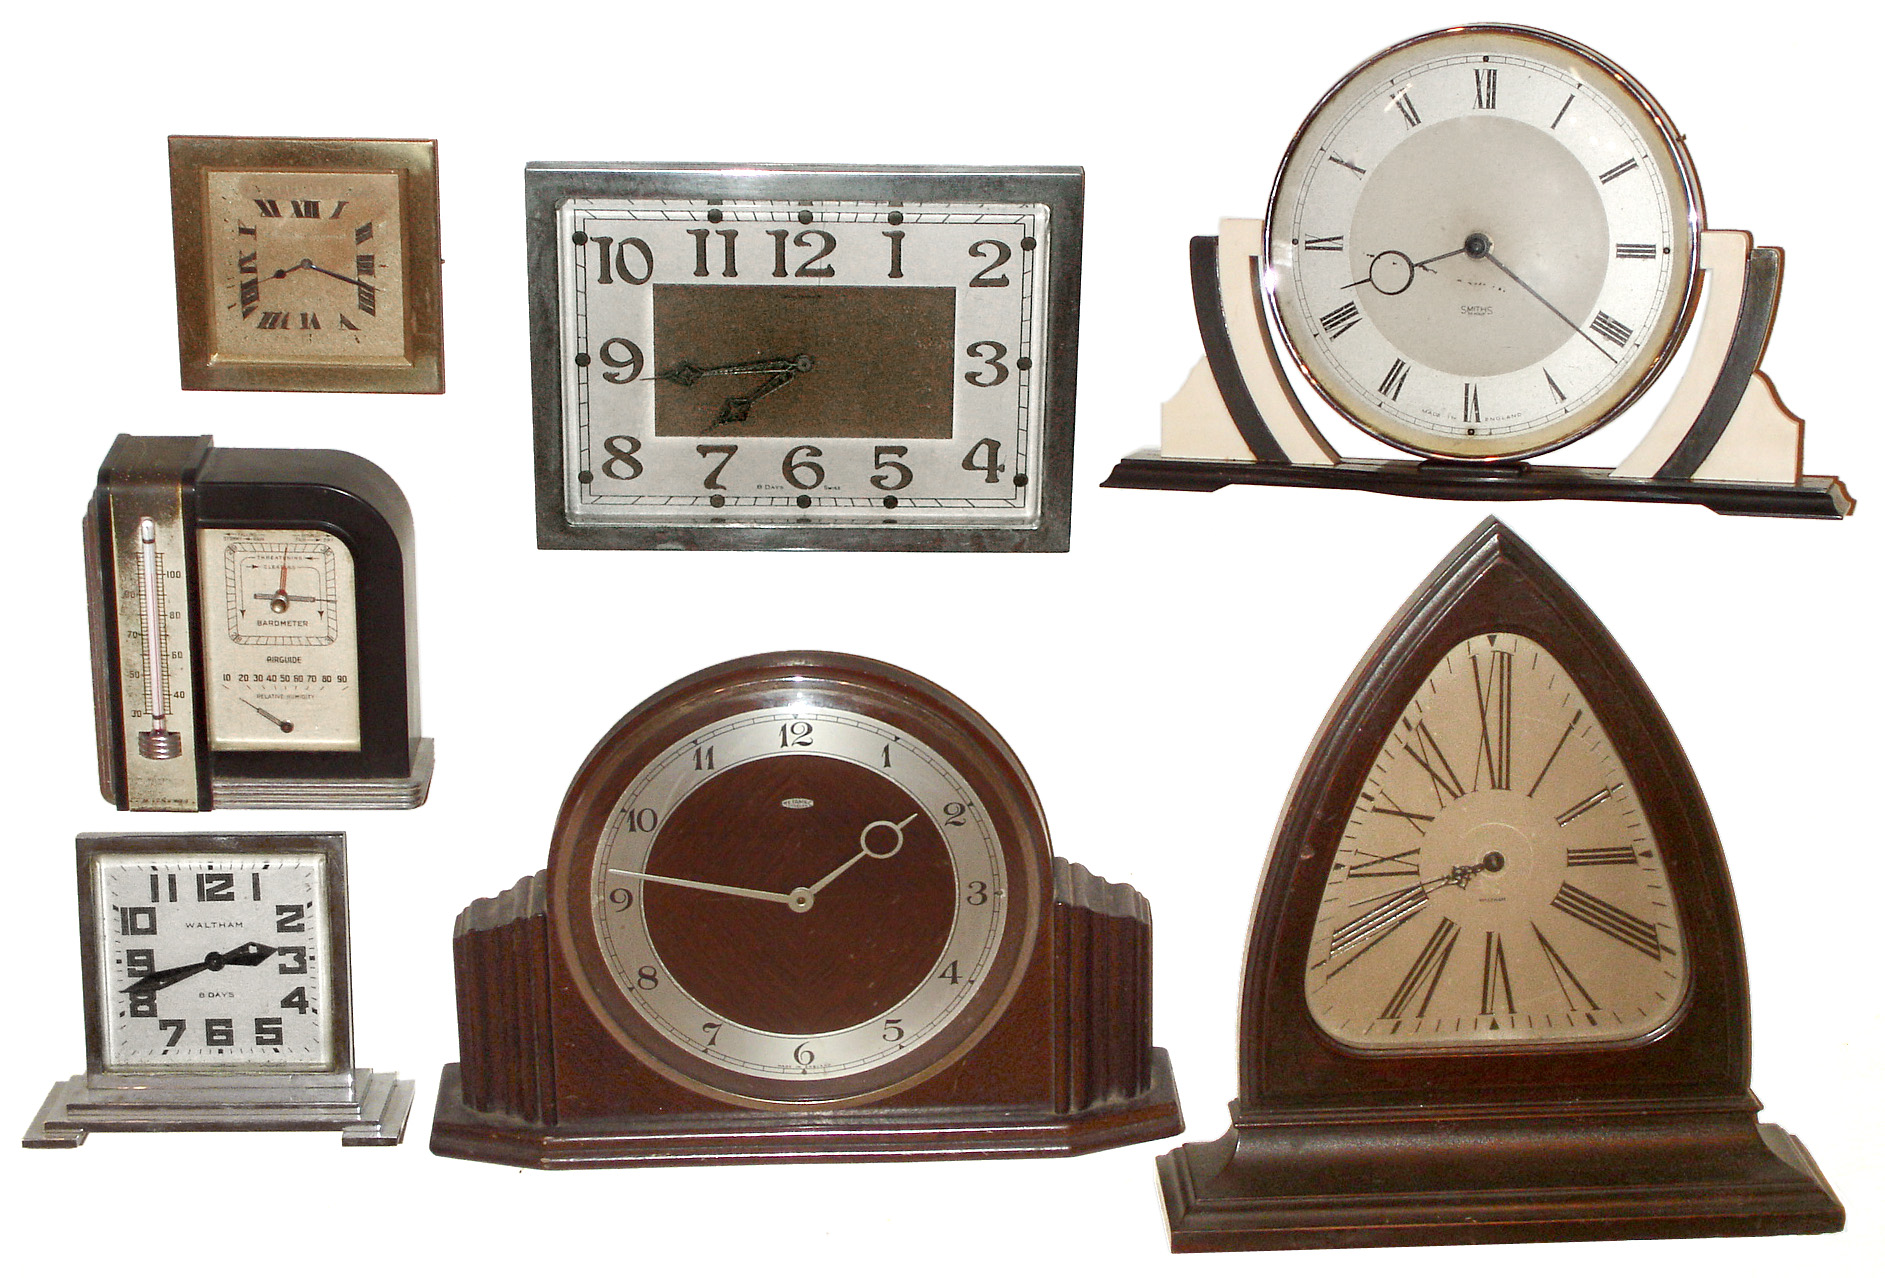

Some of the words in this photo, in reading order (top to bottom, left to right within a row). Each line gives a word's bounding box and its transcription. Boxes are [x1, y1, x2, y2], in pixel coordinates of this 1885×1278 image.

[1473, 68, 1498, 110] XII
[1389, 86, 1422, 131] XI
[1328, 149, 1367, 181] X
[1598, 157, 1639, 185] II
[686, 228, 739, 278] 11
[766, 229, 837, 278] 12
[882, 230, 906, 279] 1
[1304, 232, 1344, 252] IX
[1615, 242, 1657, 260] III
[590, 236, 655, 285] 10
[967, 239, 1012, 288] 2
[1319, 300, 1363, 342] VIII
[1460, 305, 1494, 315] SMITHS
[1589, 309, 1634, 348] IIII
[599, 337, 644, 385] 9
[964, 340, 1009, 387] 3
[1377, 358, 1412, 402] VII
[1422, 408, 1441, 418] MADE
[1484, 412, 1522, 422] ENGLAND
[602, 435, 644, 481] 8
[696, 444, 739, 490] 7
[782, 445, 825, 491] 6
[870, 445, 913, 491] 5
[961, 438, 1005, 484] 4
[166, 570, 181, 579] 100
[169, 611, 181, 619] 80
[127, 630, 138, 639] 70
[171, 651, 183, 659] 60
[266, 655, 302, 664] AIRGUIDE
[129, 670, 140, 679] 50
[223, 673, 231, 682] 10
[238, 673, 249, 682] 20
[253, 674, 264, 682] 30
[266, 674, 277, 682] 40
[280, 674, 291, 683] 50
[293, 674, 304, 683] 60
[307, 674, 317, 683] 70
[321, 675, 332, 683] 80
[337, 675, 348, 684] 90
[173, 690, 185, 699] 40
[131, 709, 142, 718] 30
[1469, 650, 1514, 792] XII
[779, 721, 814, 749] 12
[692, 744, 715, 771] 11
[881, 743, 892, 768] 1
[626, 807, 659, 833] 10
[943, 802, 967, 827] 2
[1555, 785, 1613, 827] II
[1566, 846, 1638, 867] III
[150, 873, 178, 903] 11
[196, 873, 235, 902] 12
[252, 872, 261, 901] 1
[609, 887, 634, 913] 9
[966, 880, 988, 906] 3
[120, 906, 158, 936] 10
[275, 904, 305, 933] 2
[1550, 880, 1662, 962] IIII
[126, 949, 156, 977] 9
[278, 946, 308, 975] 3
[938, 960, 963, 985] 4
[637, 965, 660, 990] 8
[129, 988, 158, 1018] 8
[280, 986, 309, 1015] 4
[159, 1018, 186, 1047] 7
[205, 1018, 234, 1046] 6
[254, 1017, 283, 1046] 5
[702, 1021, 723, 1047] 7
[882, 1018, 905, 1043] 5
[793, 1041, 815, 1066] 6
